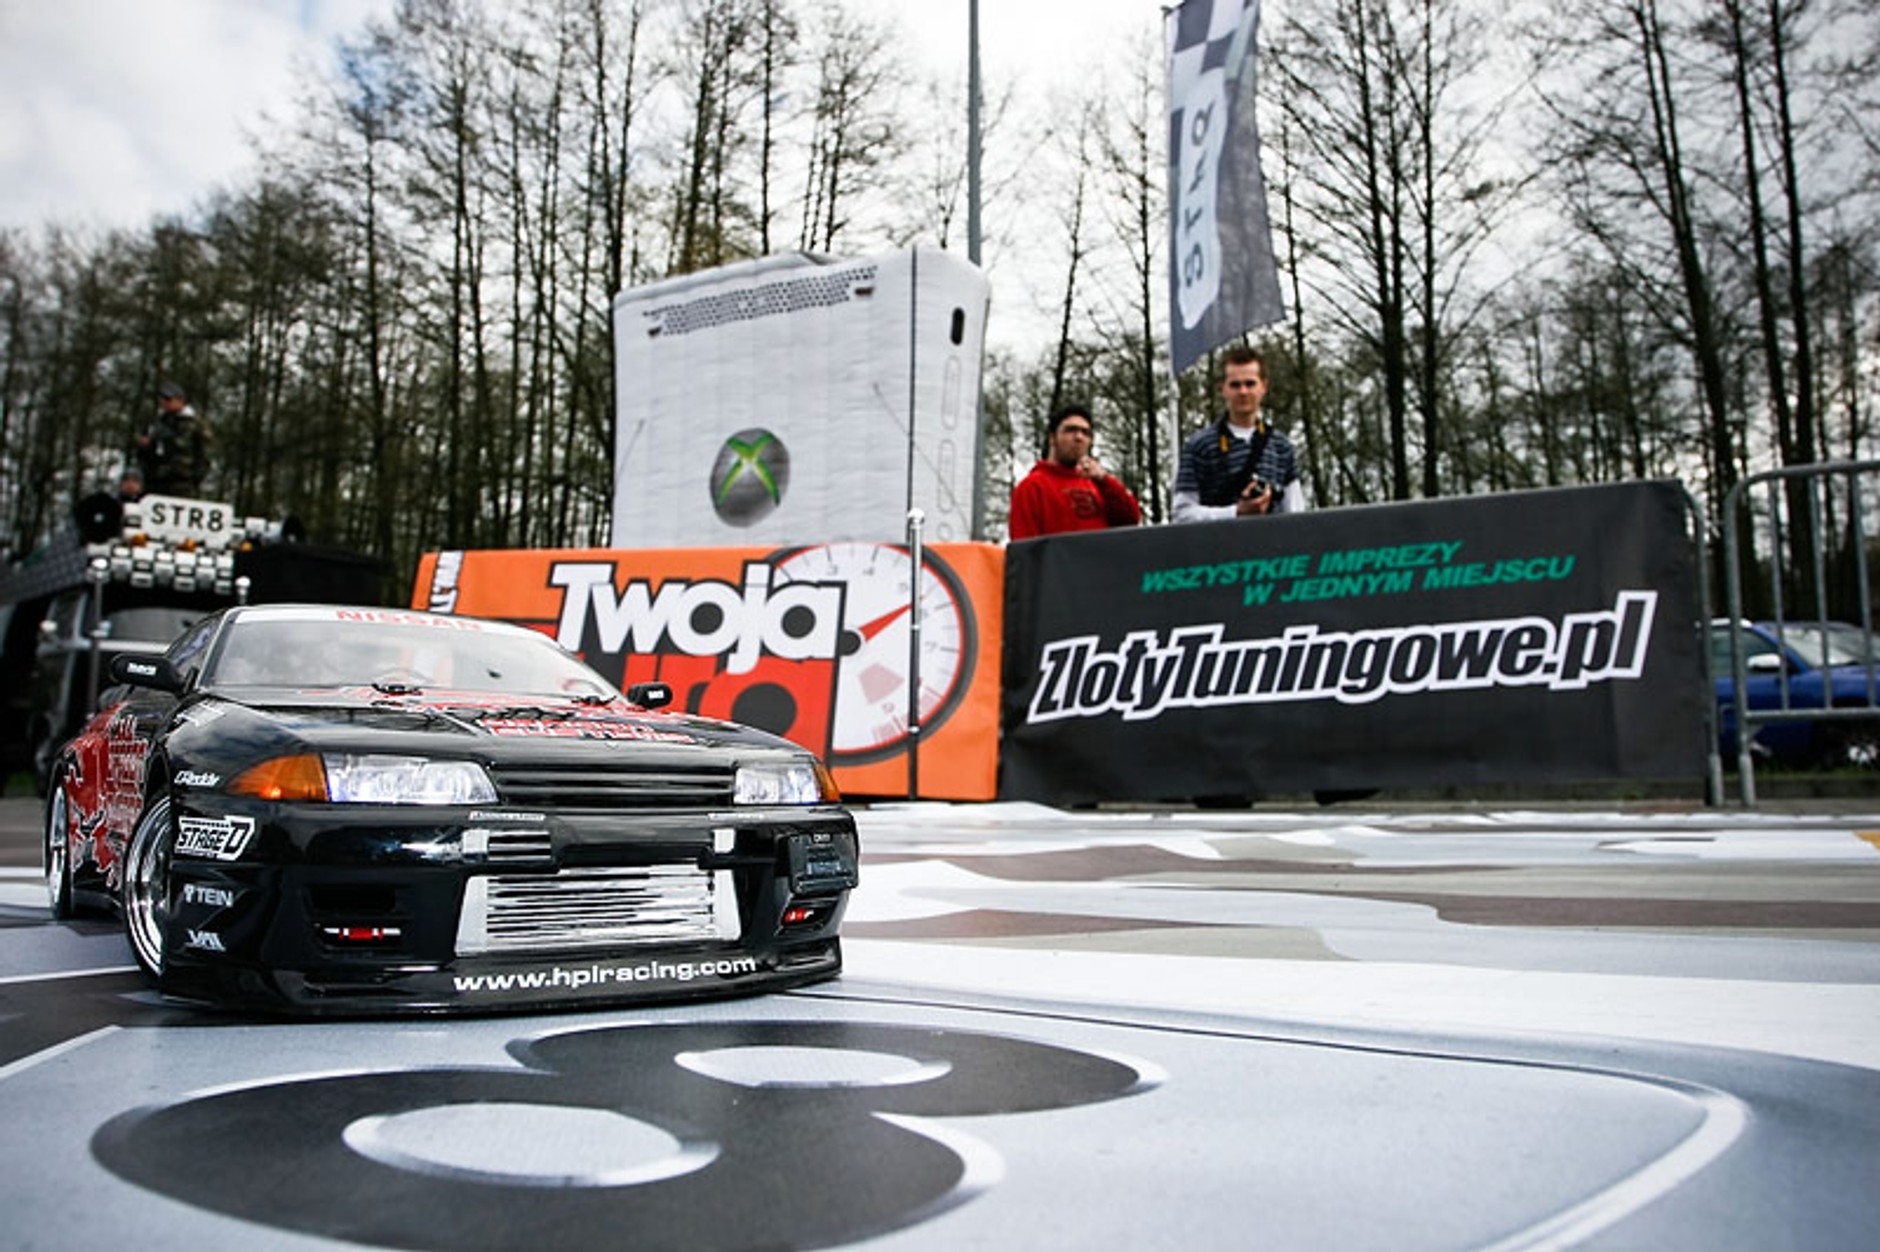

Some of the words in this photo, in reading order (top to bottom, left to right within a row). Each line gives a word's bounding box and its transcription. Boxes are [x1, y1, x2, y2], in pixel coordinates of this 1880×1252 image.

[150, 503, 225, 532] STR8
[1141, 554, 1310, 593] WSZYSTKIE
[1318, 540, 1463, 574] IMPREZY
[1243, 584, 1274, 606] W
[1279, 571, 1413, 602] JEDNYM
[1422, 554, 1576, 591] MIEJSCU
[336, 609, 482, 631] NISSAN
[549, 562, 844, 675] Twoja
[1027, 590, 1658, 723] ZlotyTuningowe.pl
[196, 886, 233, 908] TEIN
[453, 956, 757, 992] www.hpiracing.com
